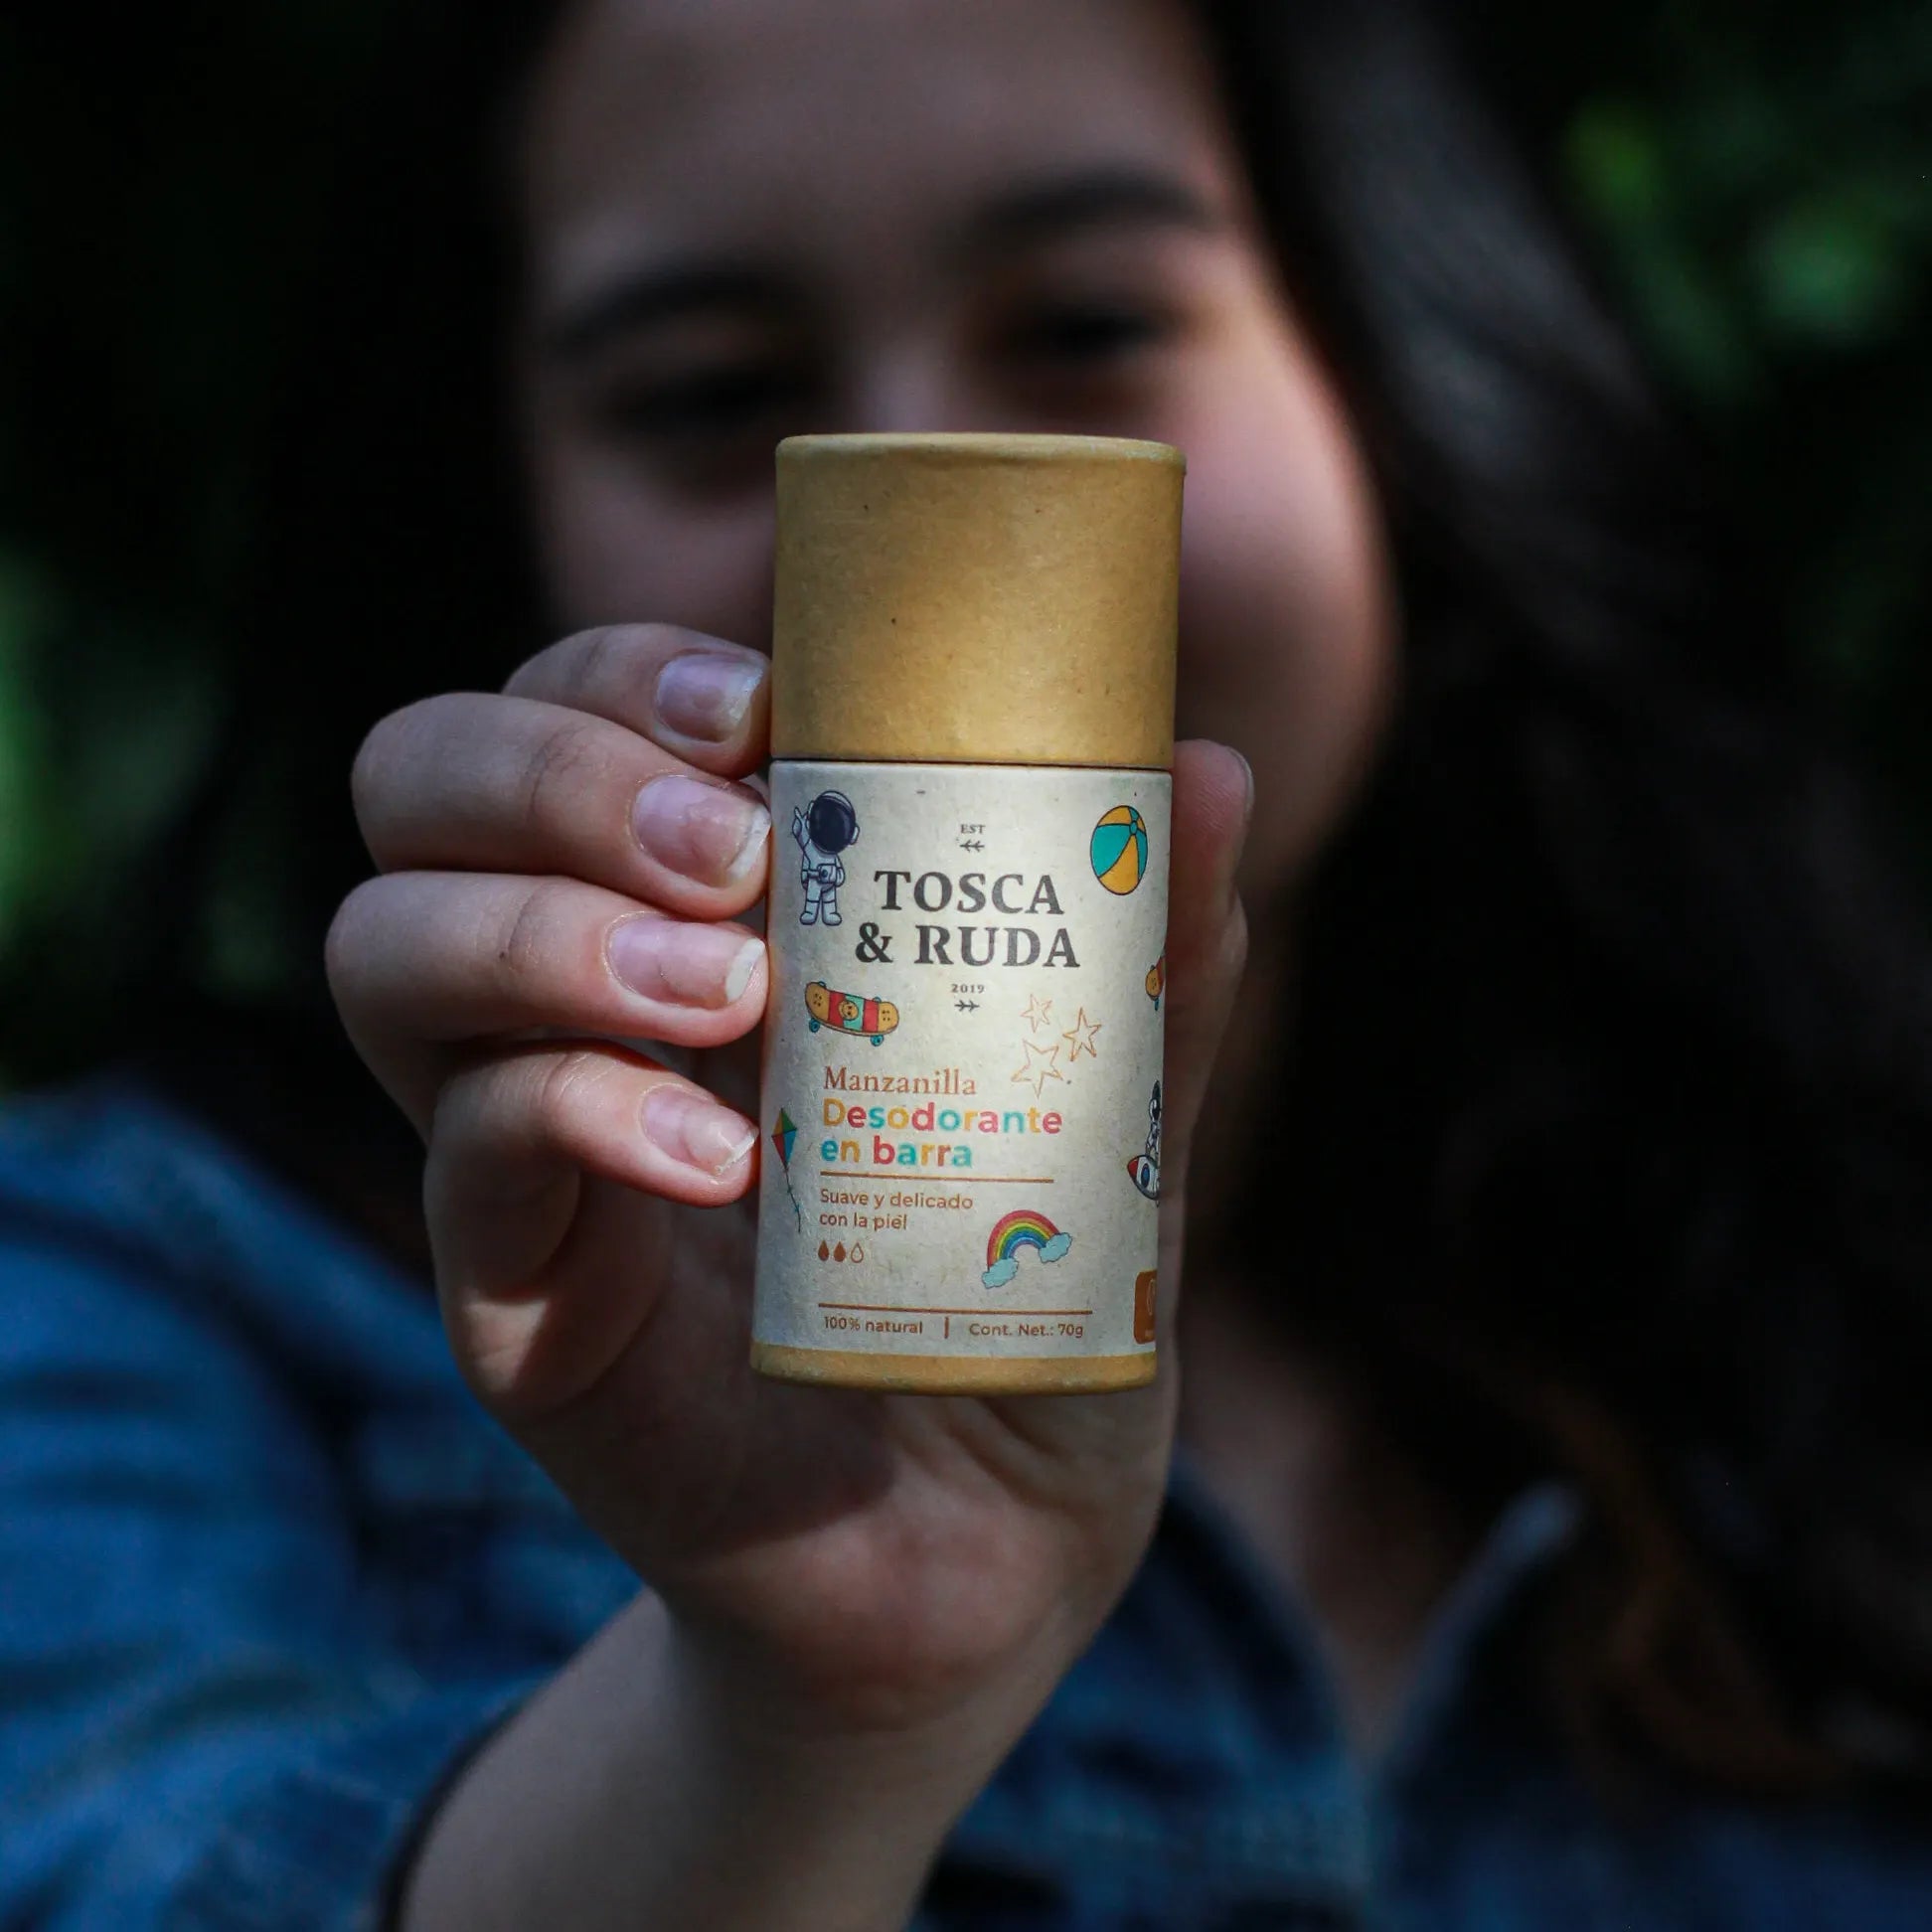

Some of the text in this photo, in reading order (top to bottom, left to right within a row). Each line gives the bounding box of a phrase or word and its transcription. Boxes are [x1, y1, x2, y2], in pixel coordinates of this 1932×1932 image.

[960, 824, 986, 835] EST
[874, 871, 1064, 915] TOSCA
[855, 921, 1080, 968] & RUDA
[951, 983, 985, 994] 2019
[824, 1066, 977, 1095] Manzanilla
[823, 1098, 1062, 1135] Desodorante
[821, 1135, 973, 1168] en barra
[820, 1189, 973, 1210] Suave y delicado
[820, 1212, 907, 1231] con la piel
[824, 1316, 923, 1335] 100% natural
[969, 1323, 1084, 1339] Cont. Net.: 70g
